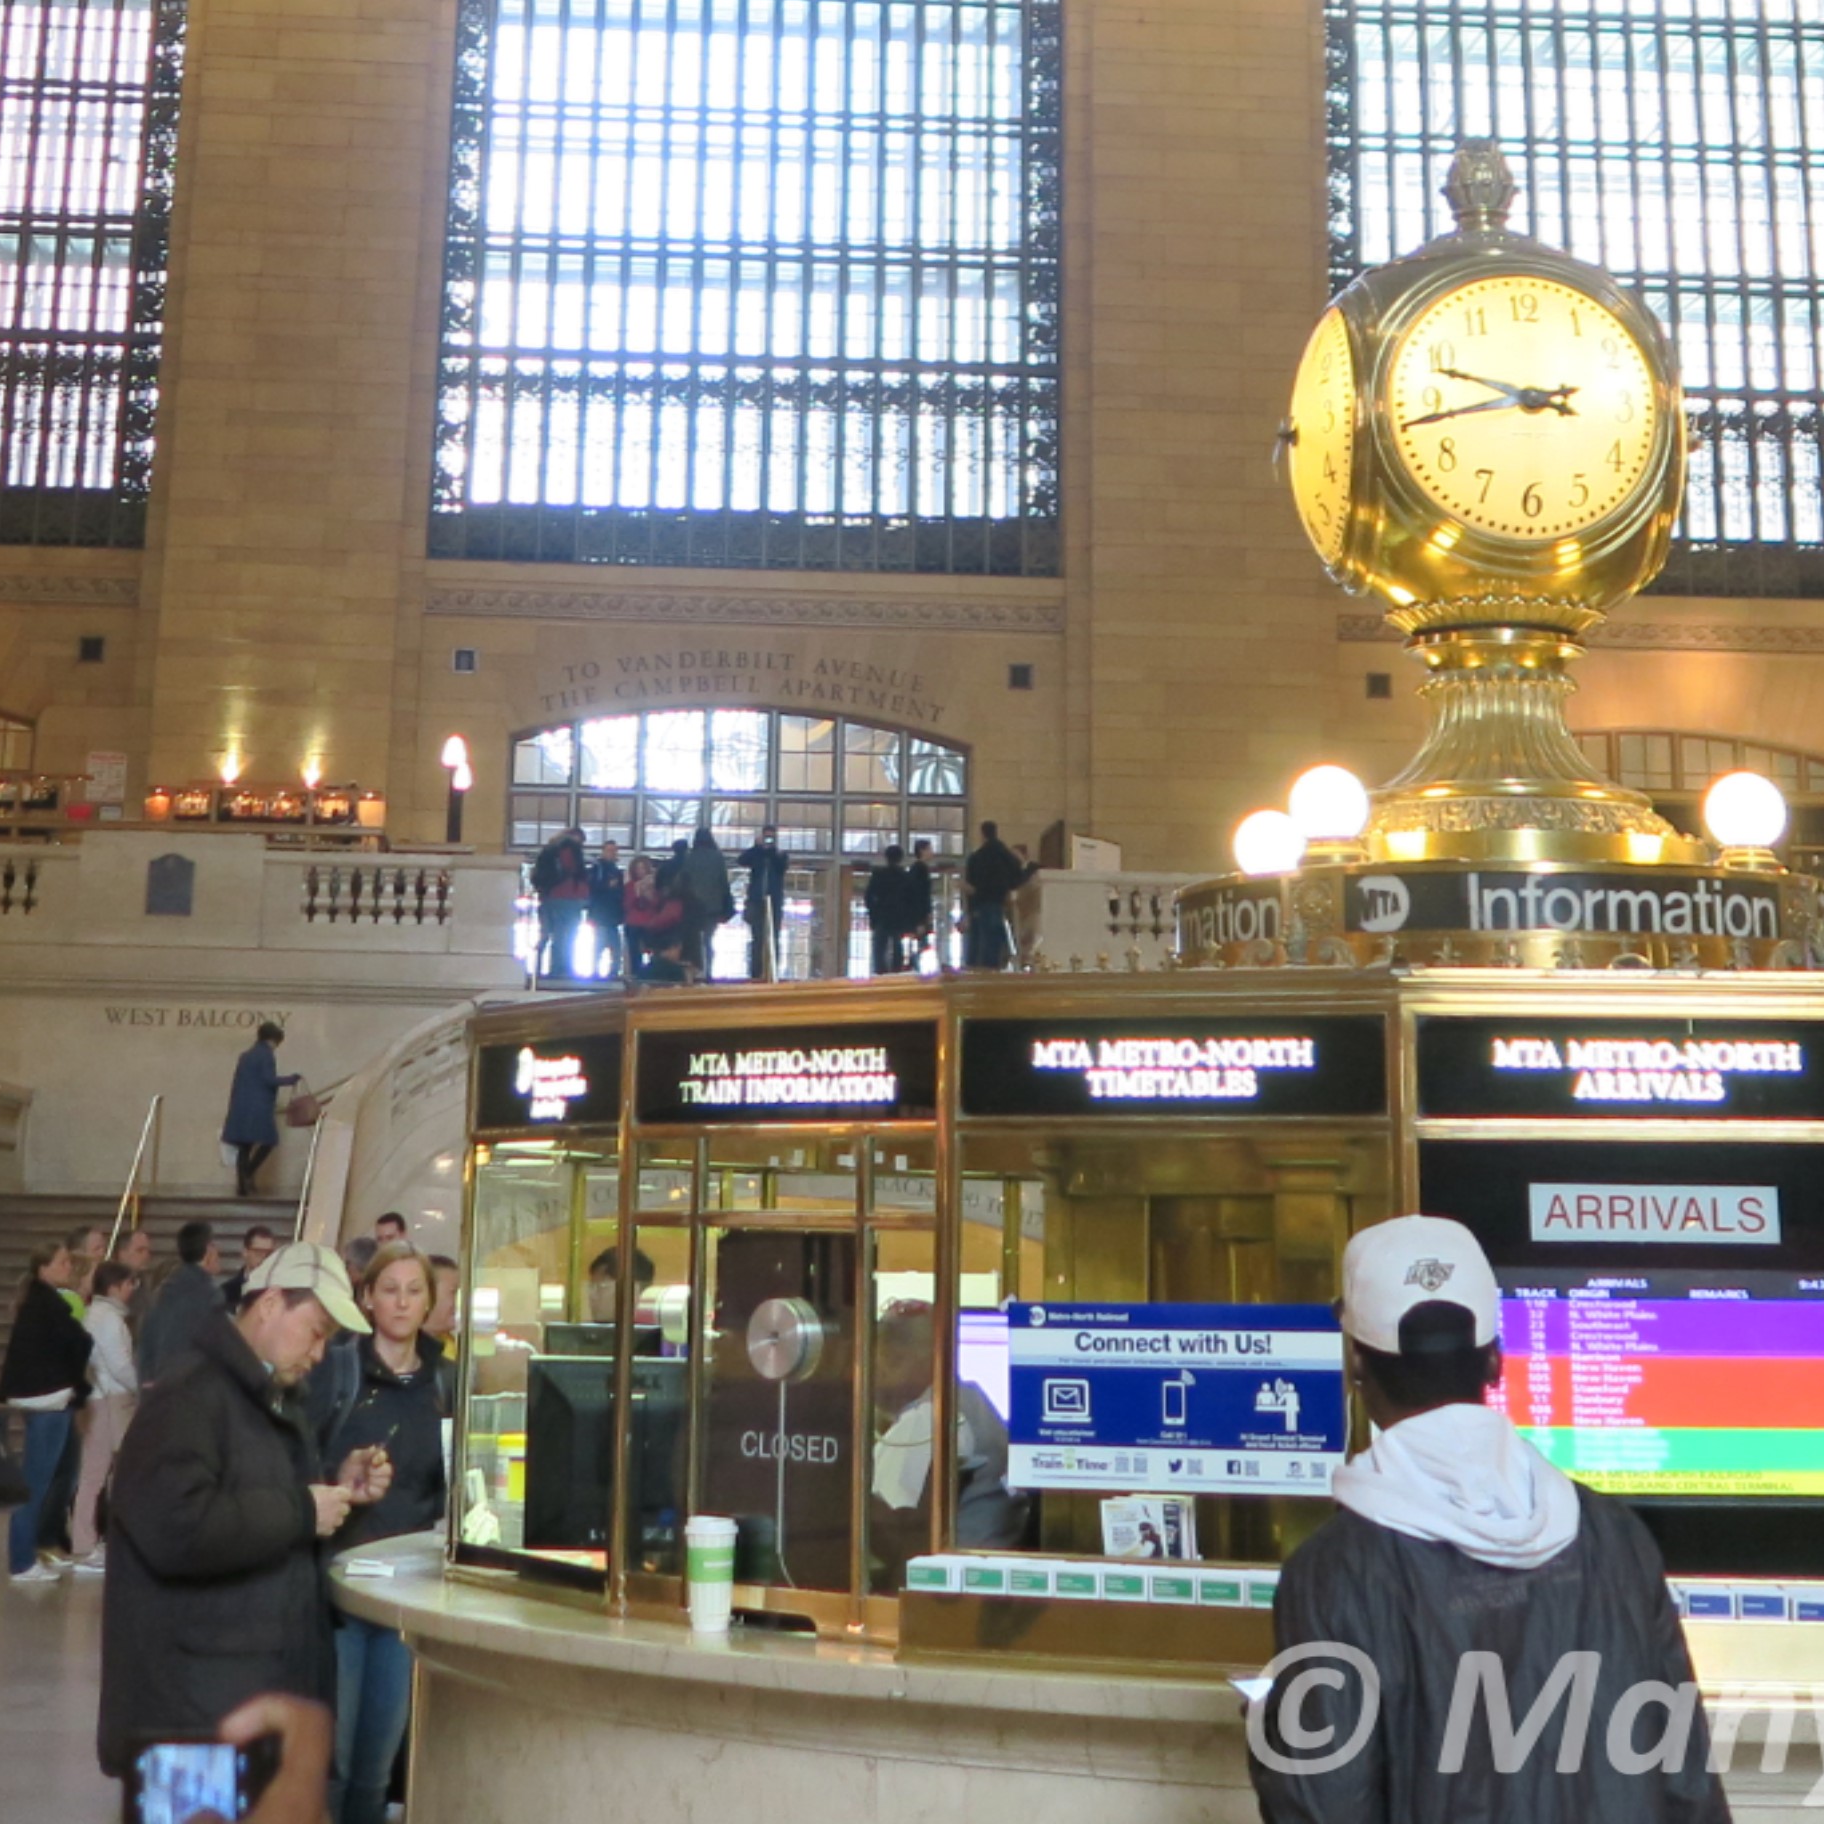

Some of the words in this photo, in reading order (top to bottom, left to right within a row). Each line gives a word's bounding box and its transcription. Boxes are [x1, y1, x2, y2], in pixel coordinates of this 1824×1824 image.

[1462, 308, 1489, 337] 11
[1509, 293, 1540, 323] 12
[1569, 307, 1582, 337] 1
[1426, 339, 1455, 371] 10
[1421, 385, 1442, 416] 9
[1615, 394, 1634, 424] 3
[1436, 437, 1458, 471] 8
[1605, 438, 1625, 473] 4
[1474, 468, 1494, 504] 7
[1521, 481, 1544, 517] 6
[1567, 473, 1589, 509] 5
[562, 659, 602, 685] TO
[617, 648, 796, 676] VANDERBILT
[812, 656, 926, 694] AVENUE
[539, 684, 597, 714] THE
[613, 674, 762, 700] CAMPBELL
[779, 676, 947, 725] APARTMENT
[1467, 871, 1776, 938] Information
[104, 1005, 171, 1027] WEST
[177, 1007, 293, 1028] BALCONY
[688, 1051, 730, 1076] MTA
[734, 1046, 887, 1076] METRO-NORTH
[1032, 1039, 1093, 1068] MTA
[1098, 1037, 1315, 1068] METRO-NORTH
[1491, 1038, 1562, 1069] MTA
[1566, 1038, 1803, 1071] METRO-NORTH
[678, 1077, 742, 1104] TRAIN
[745, 1072, 897, 1104] INFORMATION
[1086, 1068, 1258, 1098] TIMETABLES
[1572, 1069, 1726, 1101] ARRIVALS
[1543, 1193, 1767, 1234] ARRIVALS
[1514, 1288, 1557, 1298] TRACK
[1568, 1288, 1611, 1298] ORIGIN
[1688, 1289, 1749, 1299] REMARKS
[1587, 1278, 1648, 1289] ARRIVALS
[1074, 1331, 1173, 1354] Connect
[1176, 1333, 1228, 1355] with
[1234, 1333, 1273, 1356] Us!
[740, 1429, 839, 1464] CLOSED
[1032, 1456, 1065, 1469] Train
[1076, 1457, 1109, 1471] Time
